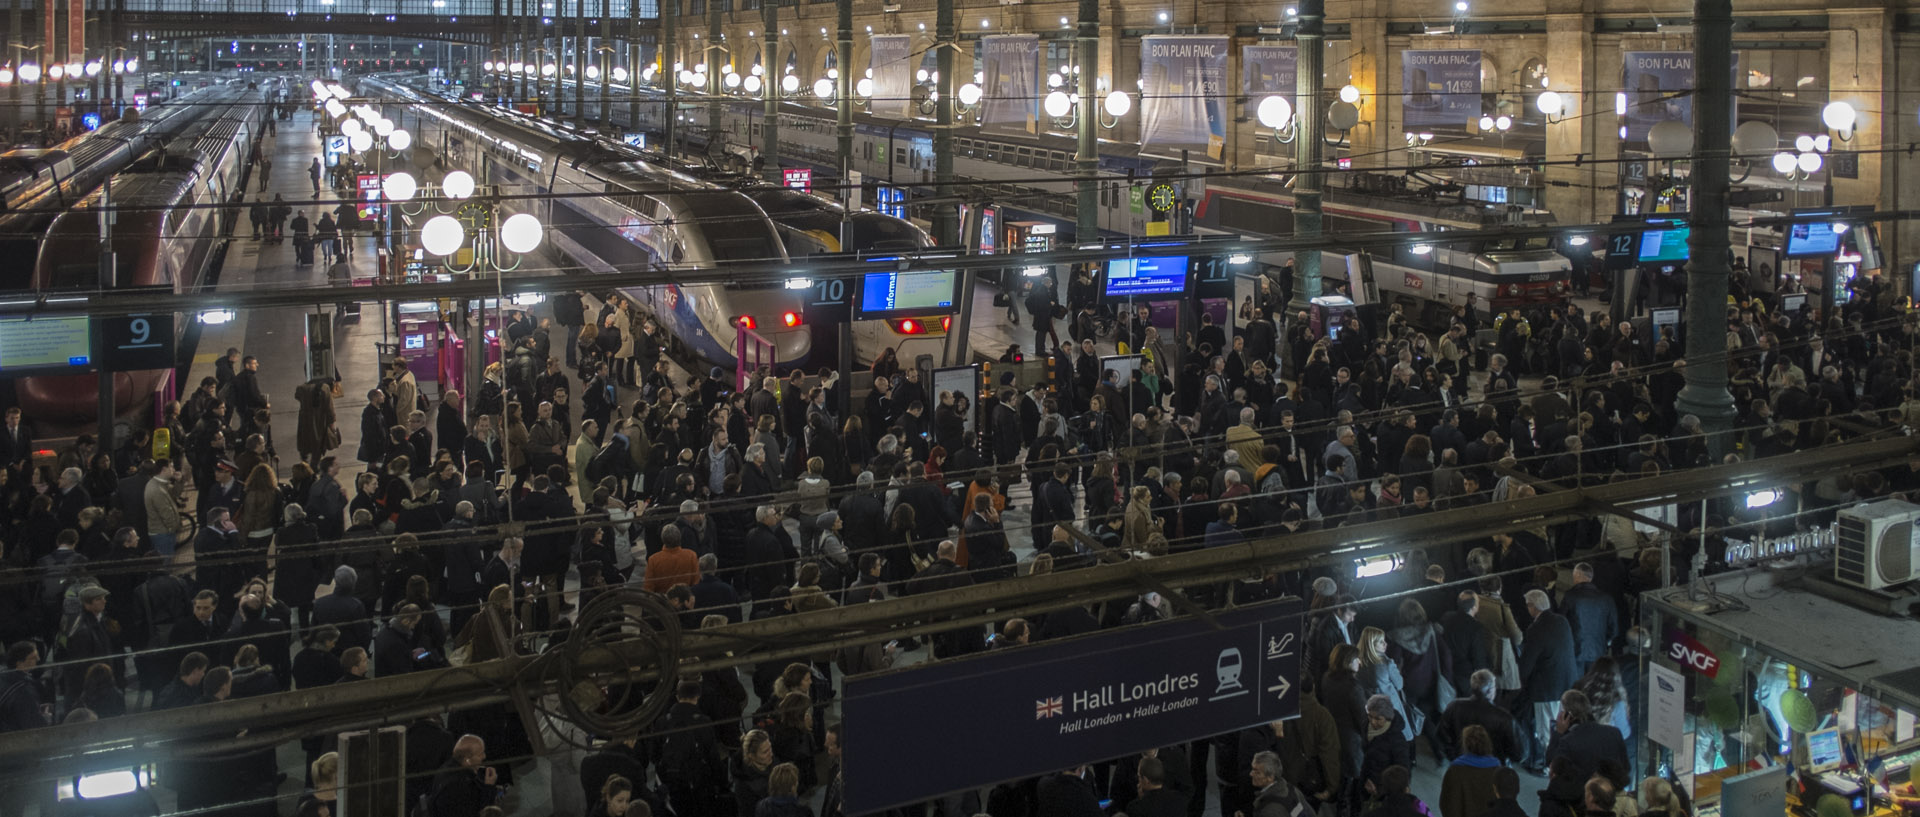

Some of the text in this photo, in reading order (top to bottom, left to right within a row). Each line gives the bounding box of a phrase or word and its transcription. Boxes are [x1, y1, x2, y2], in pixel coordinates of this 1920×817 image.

[1152, 45, 1215, 58] BON PLAN FNAC
[1412, 56, 1470, 64] BON PLAN FNAC
[1639, 58, 1691, 70] BON PLAN
[1629, 164, 1644, 178] 12
[1838, 160, 1852, 172] 13
[1614, 236, 1632, 252] 12
[1206, 260, 1227, 278] 11
[1405, 276, 1422, 287] SNCF
[816, 280, 844, 301] 10
[130, 318, 150, 344] 9
[1670, 642, 1717, 670] SNCF
[1073, 672, 1198, 712] Hall Londres
[1060, 696, 1198, 734] Hall London Halle London
